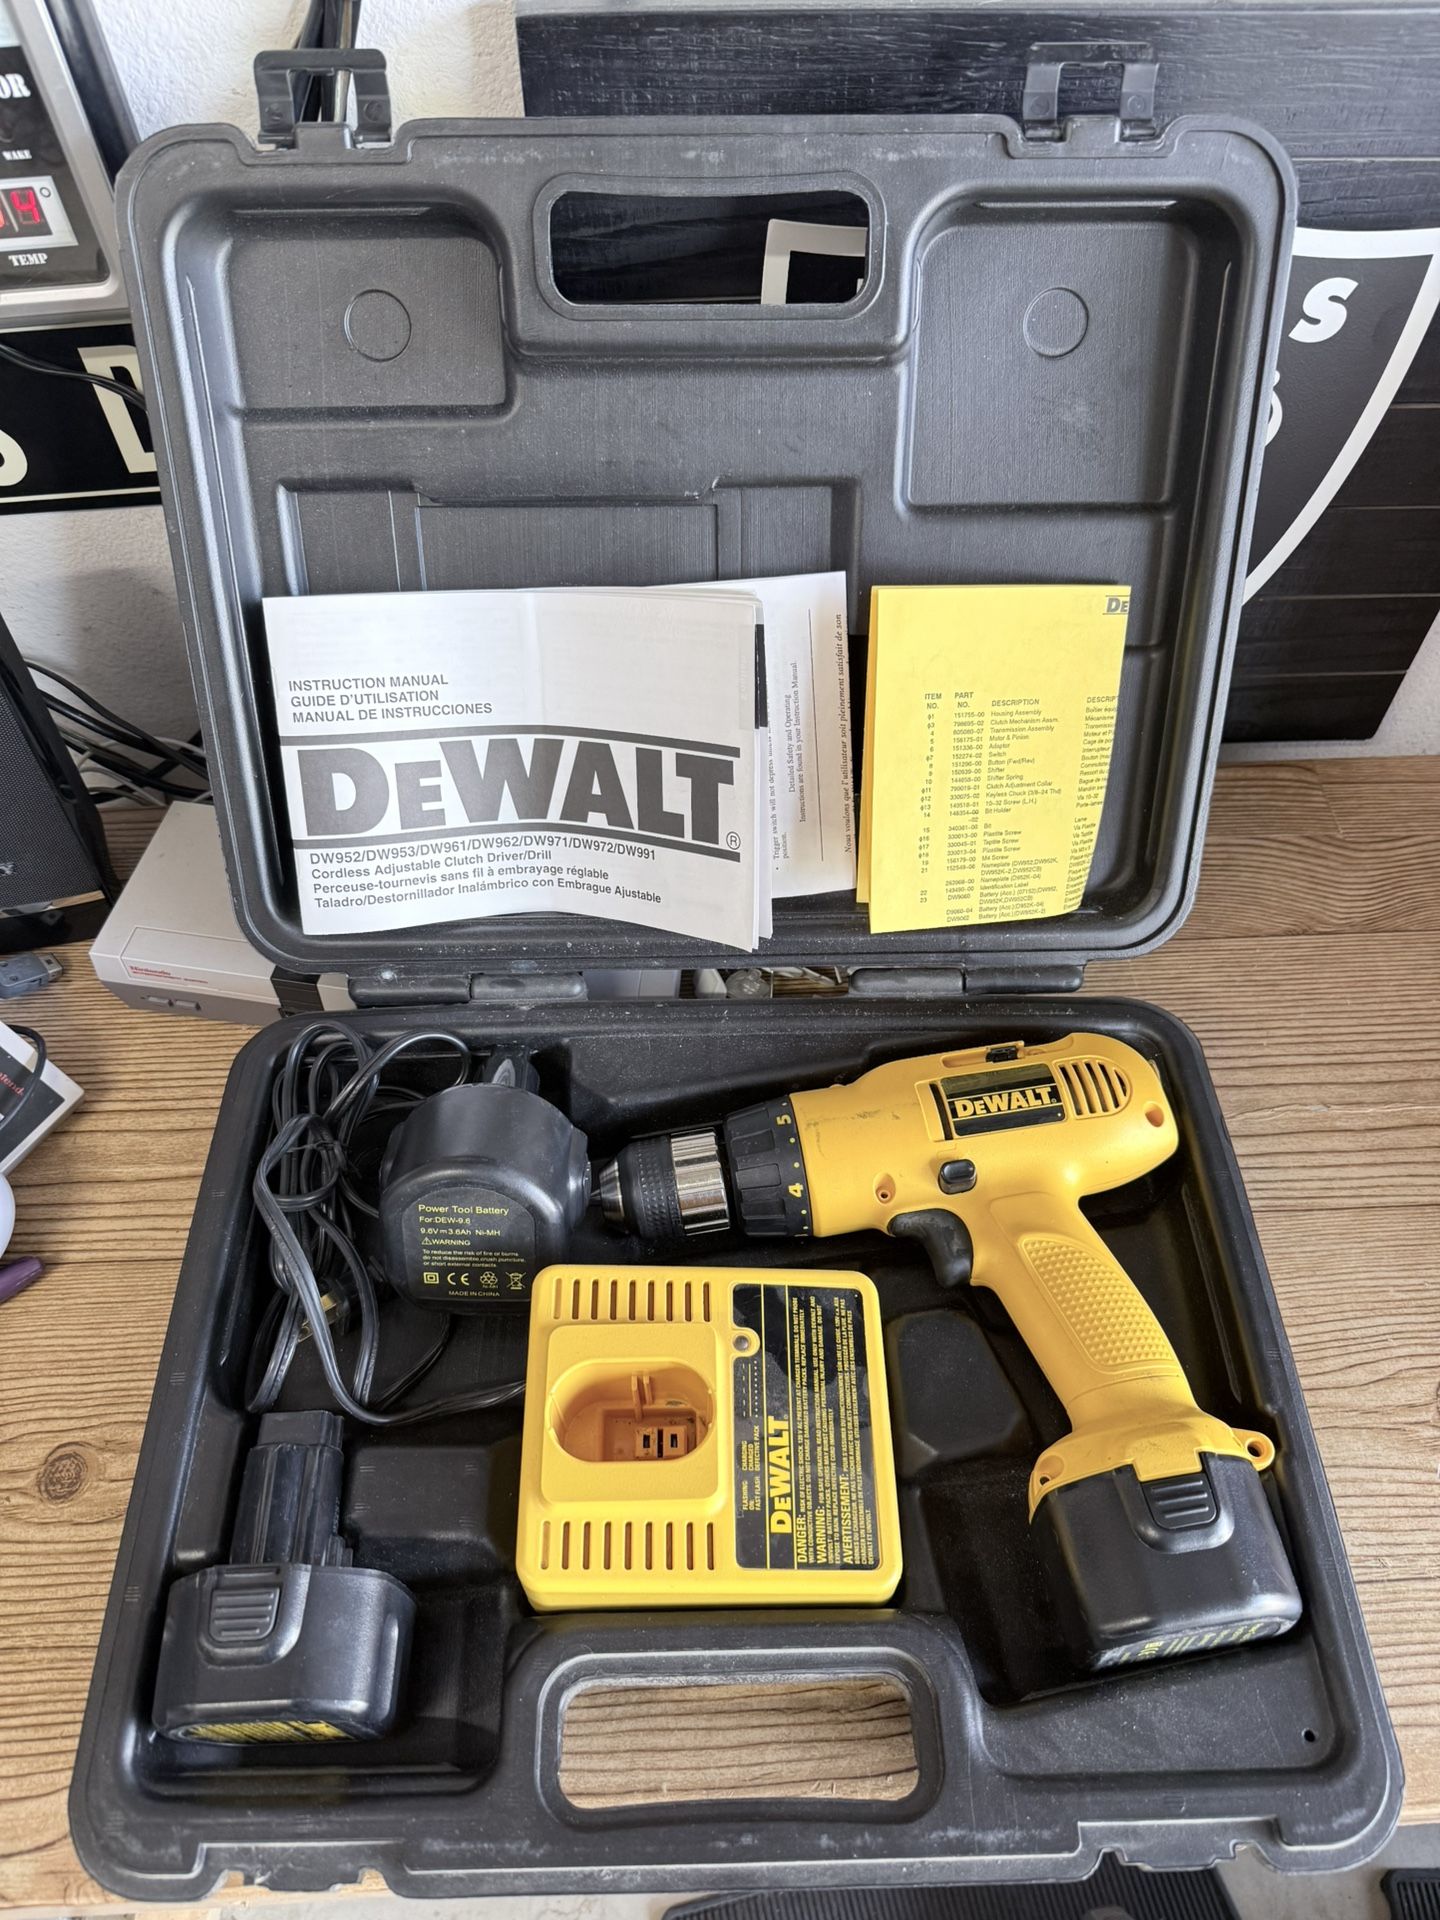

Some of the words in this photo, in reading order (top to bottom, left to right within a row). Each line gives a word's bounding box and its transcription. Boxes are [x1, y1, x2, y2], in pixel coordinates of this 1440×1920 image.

[2, 150, 32, 161] WAKE
[8, 253, 48, 266] TEMP
[1288, 277, 1359, 343] S
[835, 632, 842, 641] de
[835, 644, 845, 676] satisfait
[289, 677, 386, 692] INSTRUCTION
[390, 674, 448, 687] MANUAL
[291, 695, 336, 707] GUIDE
[340, 690, 439, 706] D'UTILISATION
[792, 690, 800, 725] Instruction
[837, 678, 848, 722] pleinement
[293, 710, 354, 723] MANUAL
[358, 708, 377, 720] DE
[382, 703, 492, 719] INSTRUCCIONES
[783, 694, 793, 728] Operating
[839, 724, 847, 738] soit
[786, 744, 794, 764] Safety
[843, 788, 851, 801] que
[844, 834, 852, 853] Nous
[311, 867, 370, 880] Cordless
[374, 859, 441, 876] Adjustable
[444, 854, 483, 868] Clutch
[488, 850, 552, 863] Driver/Drill
[313, 873, 437, 893] Perceuse-tournevis
[440, 871, 469, 882] sans
[472, 867, 484, 878] fil
[488, 867, 494, 876] à
[497, 865, 563, 876] embrayage
[566, 865, 609, 880] réglable
[314, 886, 455, 908] Taladro/Destornillador
[458, 878, 528, 894] Inalámbrico
[532, 879, 554, 887] con
[558, 878, 611, 894] Embrague
[615, 885, 661, 904] Ajustable
[777, 1115, 792, 1126] 5
[788, 1183, 803, 1198] 4
[475, 1206, 510, 1216] Battery
[839, 1474, 853, 1564] AVERTISSEMENT:
[796, 1514, 807, 1563] DANGER:
[815, 1506, 827, 1564] WARNING:
